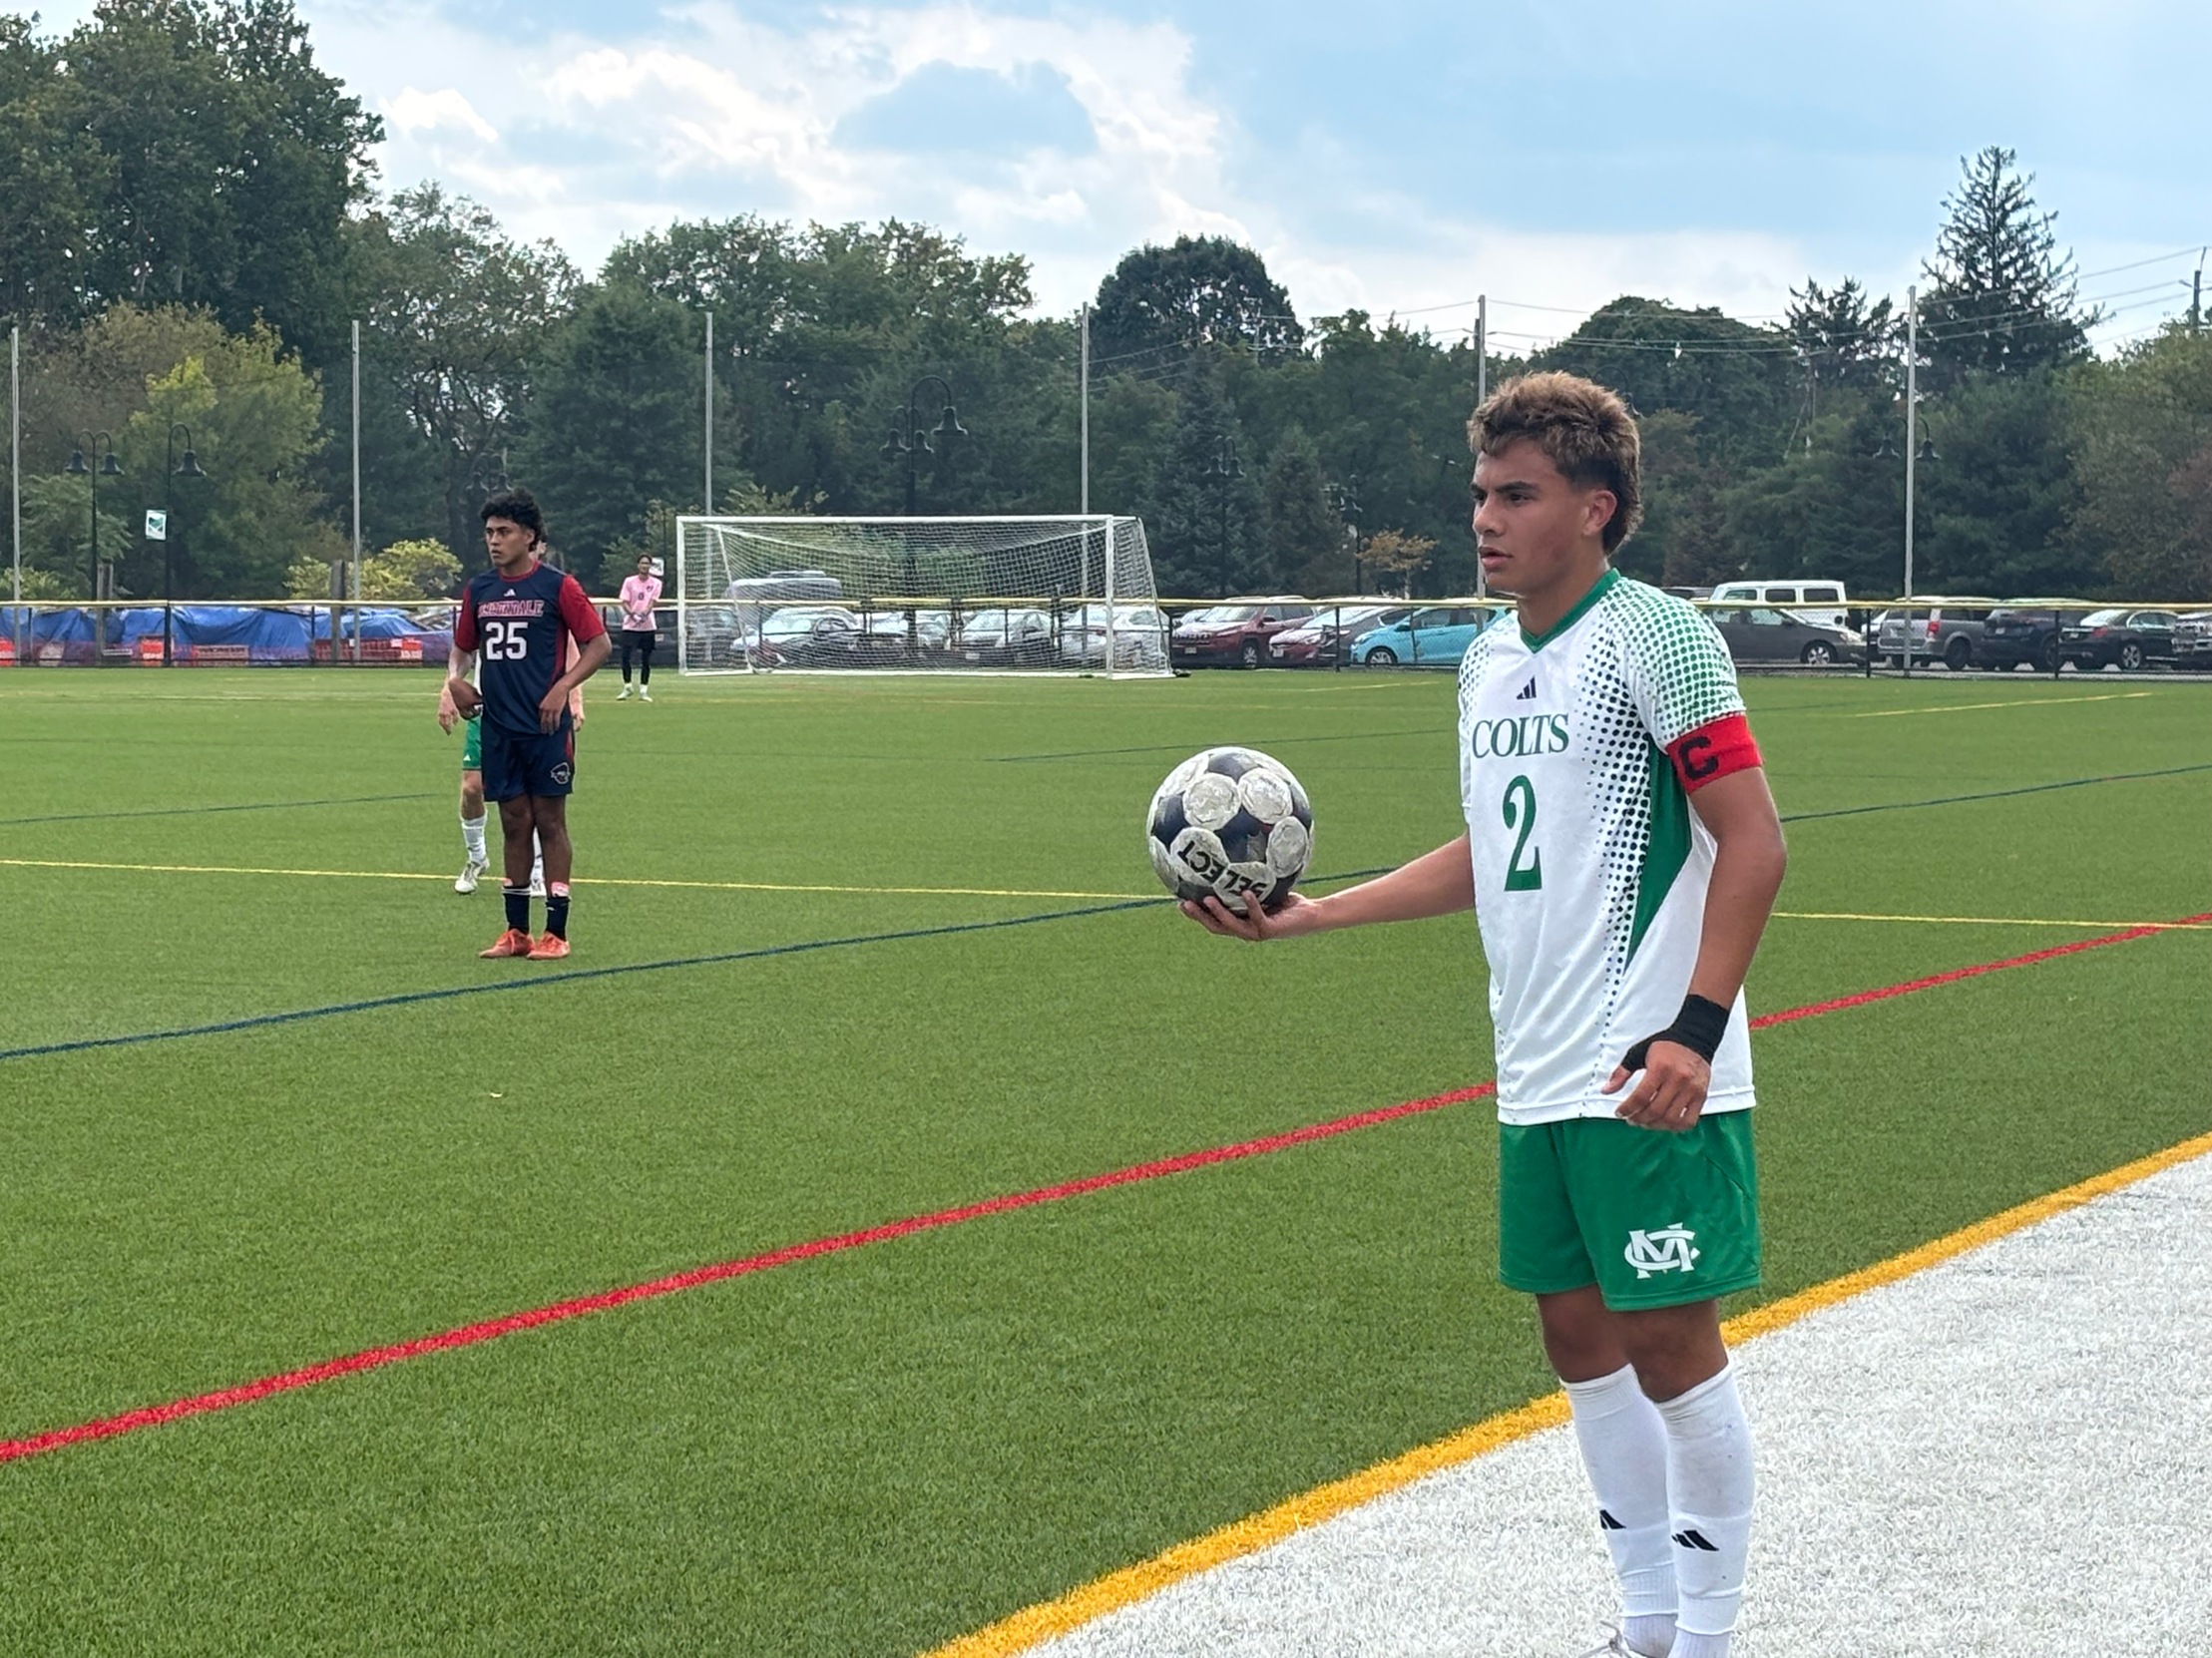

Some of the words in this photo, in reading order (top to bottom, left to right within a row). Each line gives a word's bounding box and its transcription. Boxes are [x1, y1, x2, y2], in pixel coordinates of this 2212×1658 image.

[486, 621, 529, 660] 25
[1472, 713, 1569, 759] COLTS
[1677, 735, 1720, 781] C
[1502, 774, 1543, 893] 2
[1177, 840, 1268, 898] SELECT
